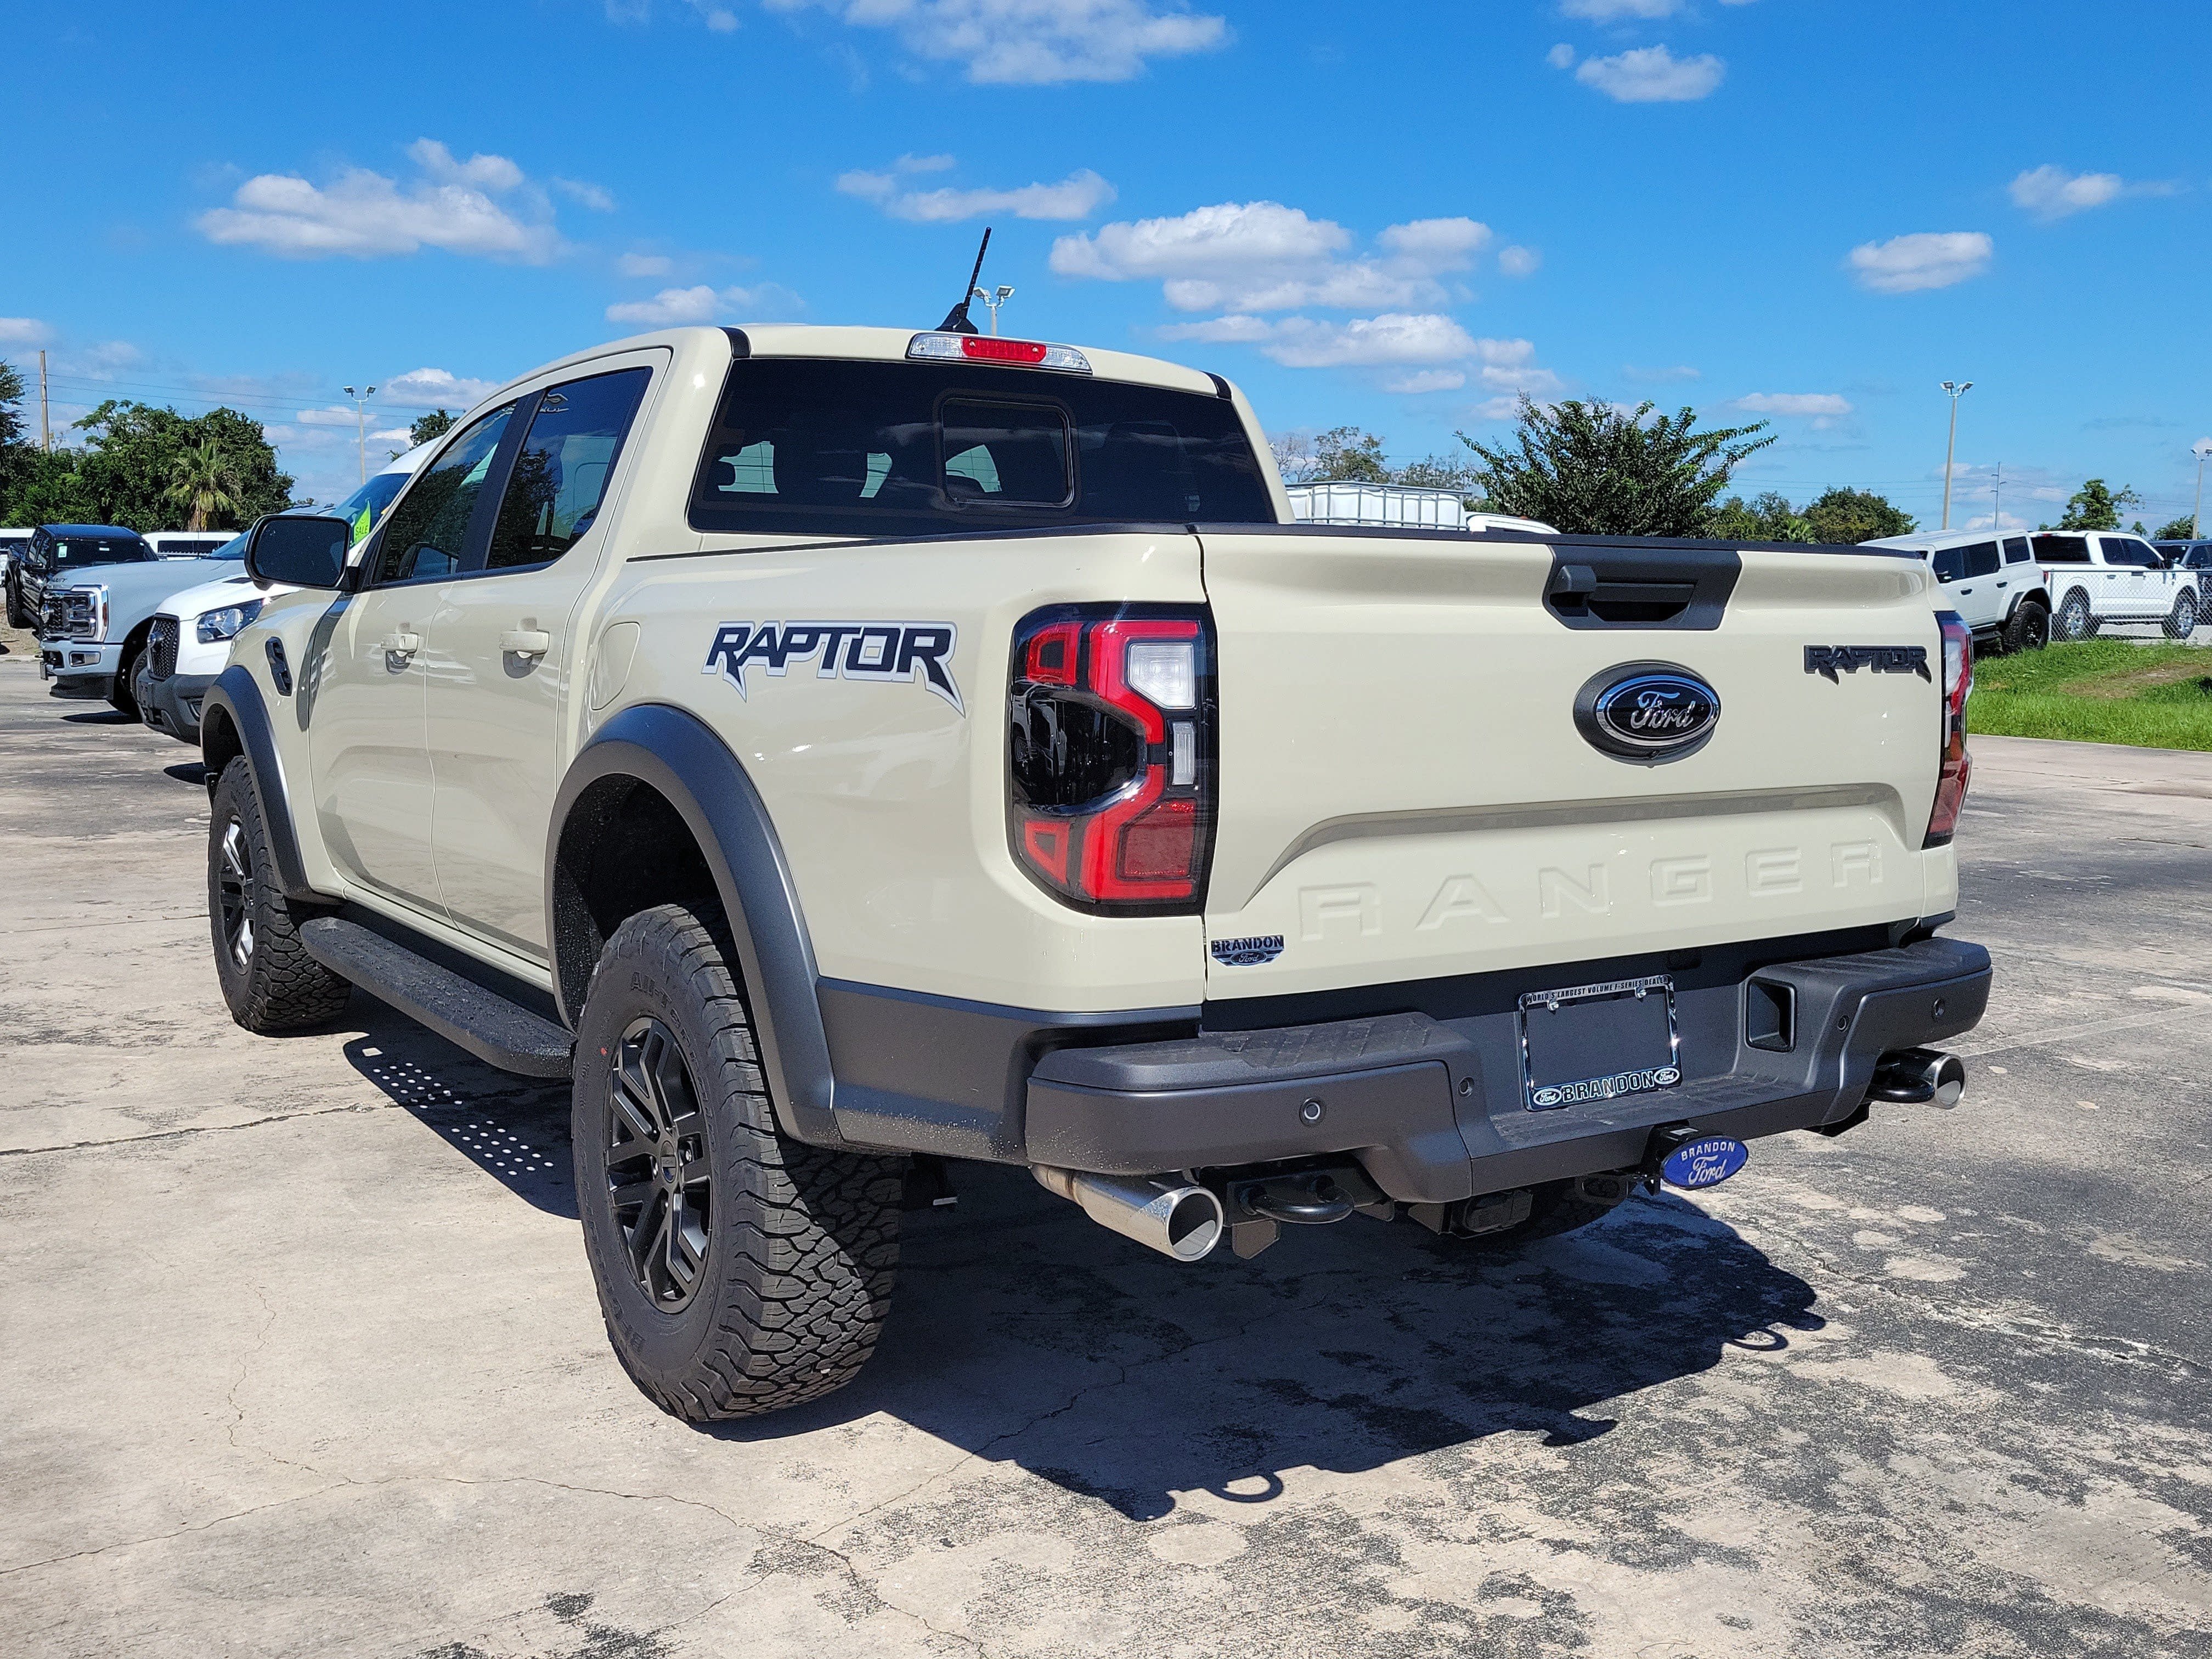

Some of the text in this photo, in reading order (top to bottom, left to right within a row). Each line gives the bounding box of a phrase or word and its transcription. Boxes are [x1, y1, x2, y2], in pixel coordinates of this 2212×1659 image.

[356, 525, 368, 535] SALE
[702, 621, 966, 718] RAPTOR
[1803, 645, 1932, 686] RAPTOR
[1630, 690, 1696, 729] Ford
[1297, 837, 1883, 941] RANGER
[1211, 935, 1284, 952] BRANDON
[1557, 988, 1586, 998] LARGEST
[1588, 983, 1613, 994] VOLUME
[1614, 979, 1643, 990] F-SERIES
[1644, 975, 1668, 986] DEALER
[1562, 1071, 1655, 1102] BRANDON
[1681, 1142, 1735, 1161] BRANDON
[1689, 1155, 1727, 1184] Ford
